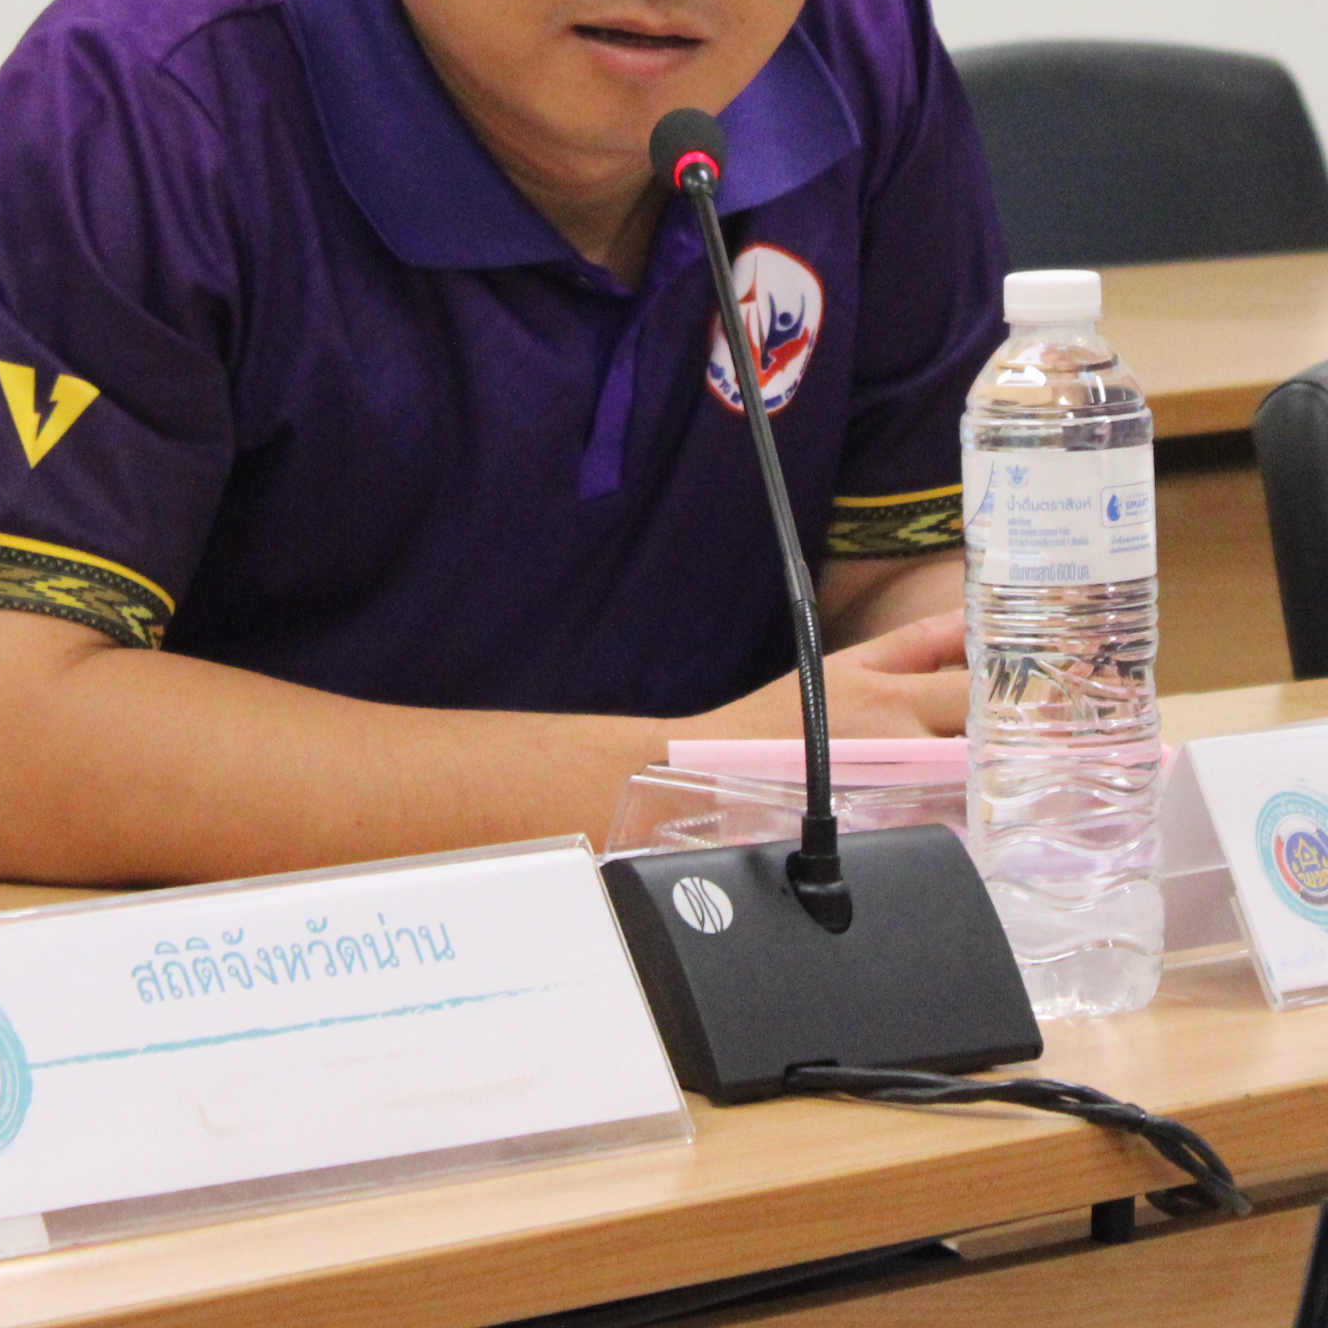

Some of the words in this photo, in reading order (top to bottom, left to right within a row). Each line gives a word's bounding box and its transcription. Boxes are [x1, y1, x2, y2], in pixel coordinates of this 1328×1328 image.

[131, 912, 456, 1003] สถิติจังหวัดน่าน
